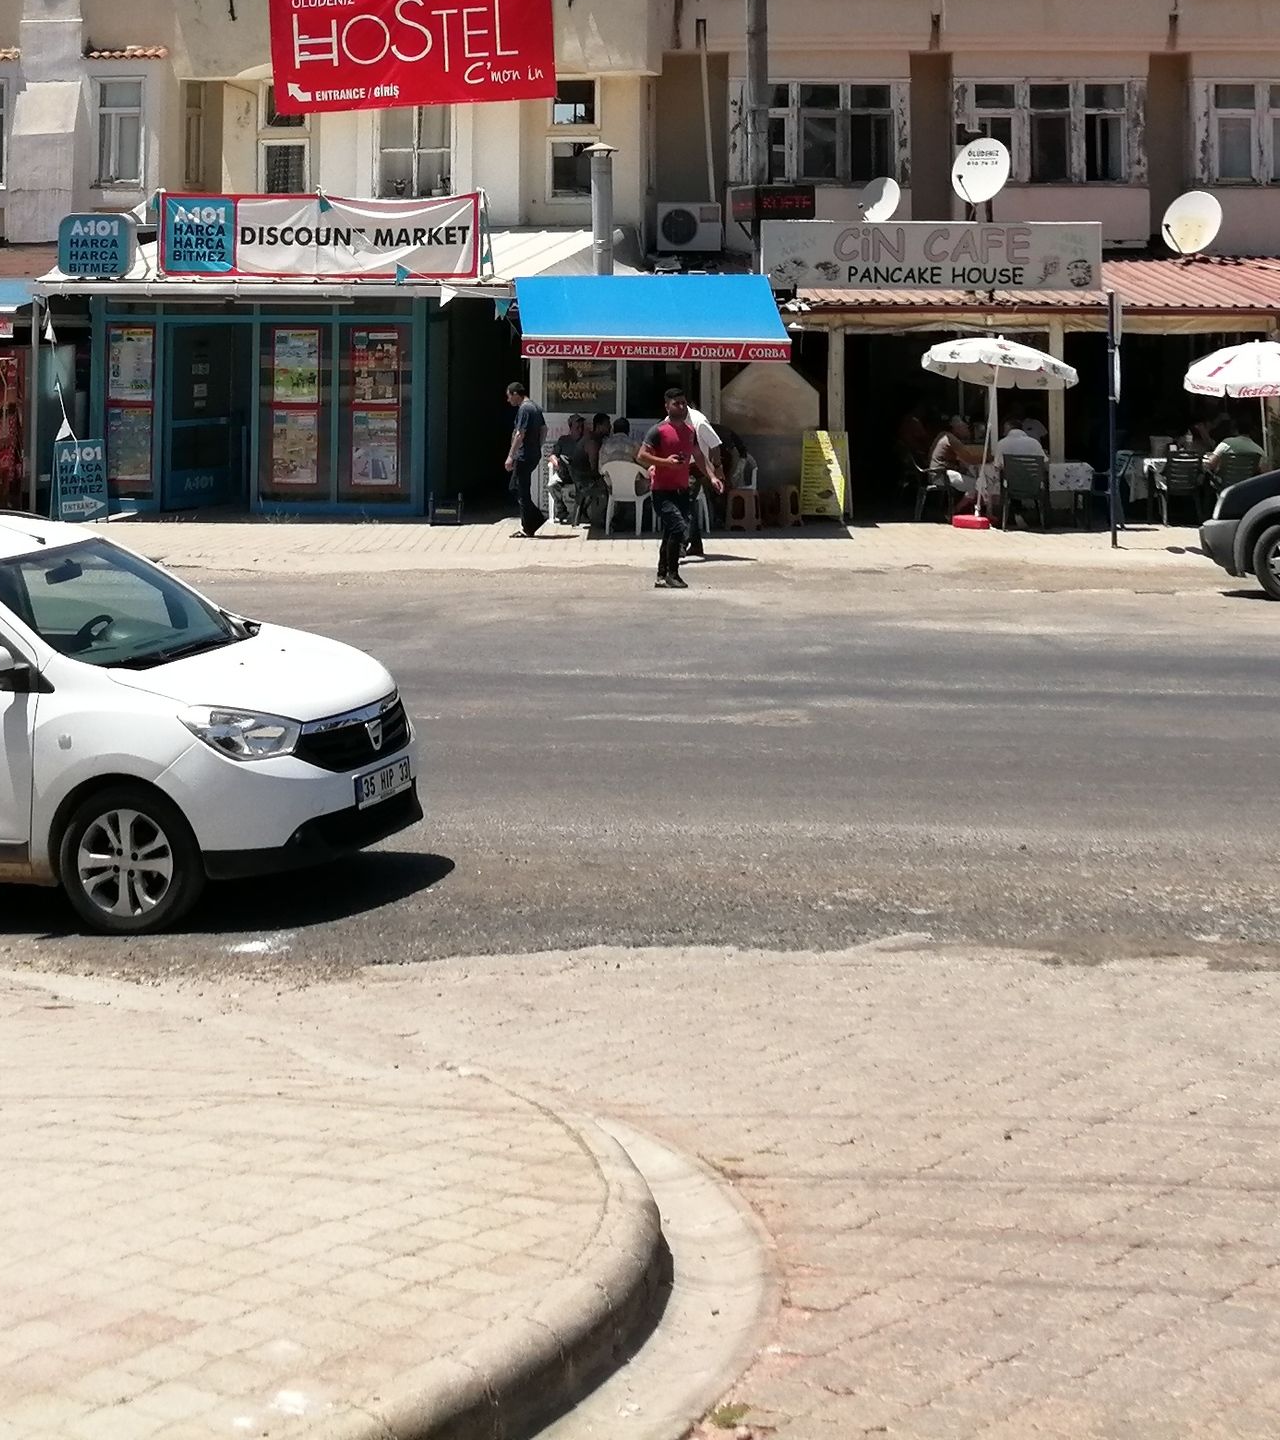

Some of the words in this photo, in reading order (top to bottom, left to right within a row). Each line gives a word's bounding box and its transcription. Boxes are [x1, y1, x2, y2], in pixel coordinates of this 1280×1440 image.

[528, 64, 544, 81] in
[315, 87, 366, 101] ENTRANCE
[374, 83, 400, 99] GİRİŞ
[174, 223, 225, 237] HARCA
[373, 226, 470, 246] MARKET
[70, 238, 119, 249] HARCA
[174, 236, 225, 250] HARCA
[923, 227, 1032, 264] CAFE
[70, 250, 119, 261] HARCA
[847, 266, 942, 284] PANCAKE
[951, 266, 1024, 284] HOUSE
[525, 342, 593, 355] GÖZLEME
[603, 345, 616, 355] EV
[620, 343, 679, 356] YEMEKLERİ
[691, 346, 735, 358] DÜRÜM
[748, 348, 787, 359] ÇORBA
[364, 776, 376, 798] 35
[380, 768, 394, 790] HIP
